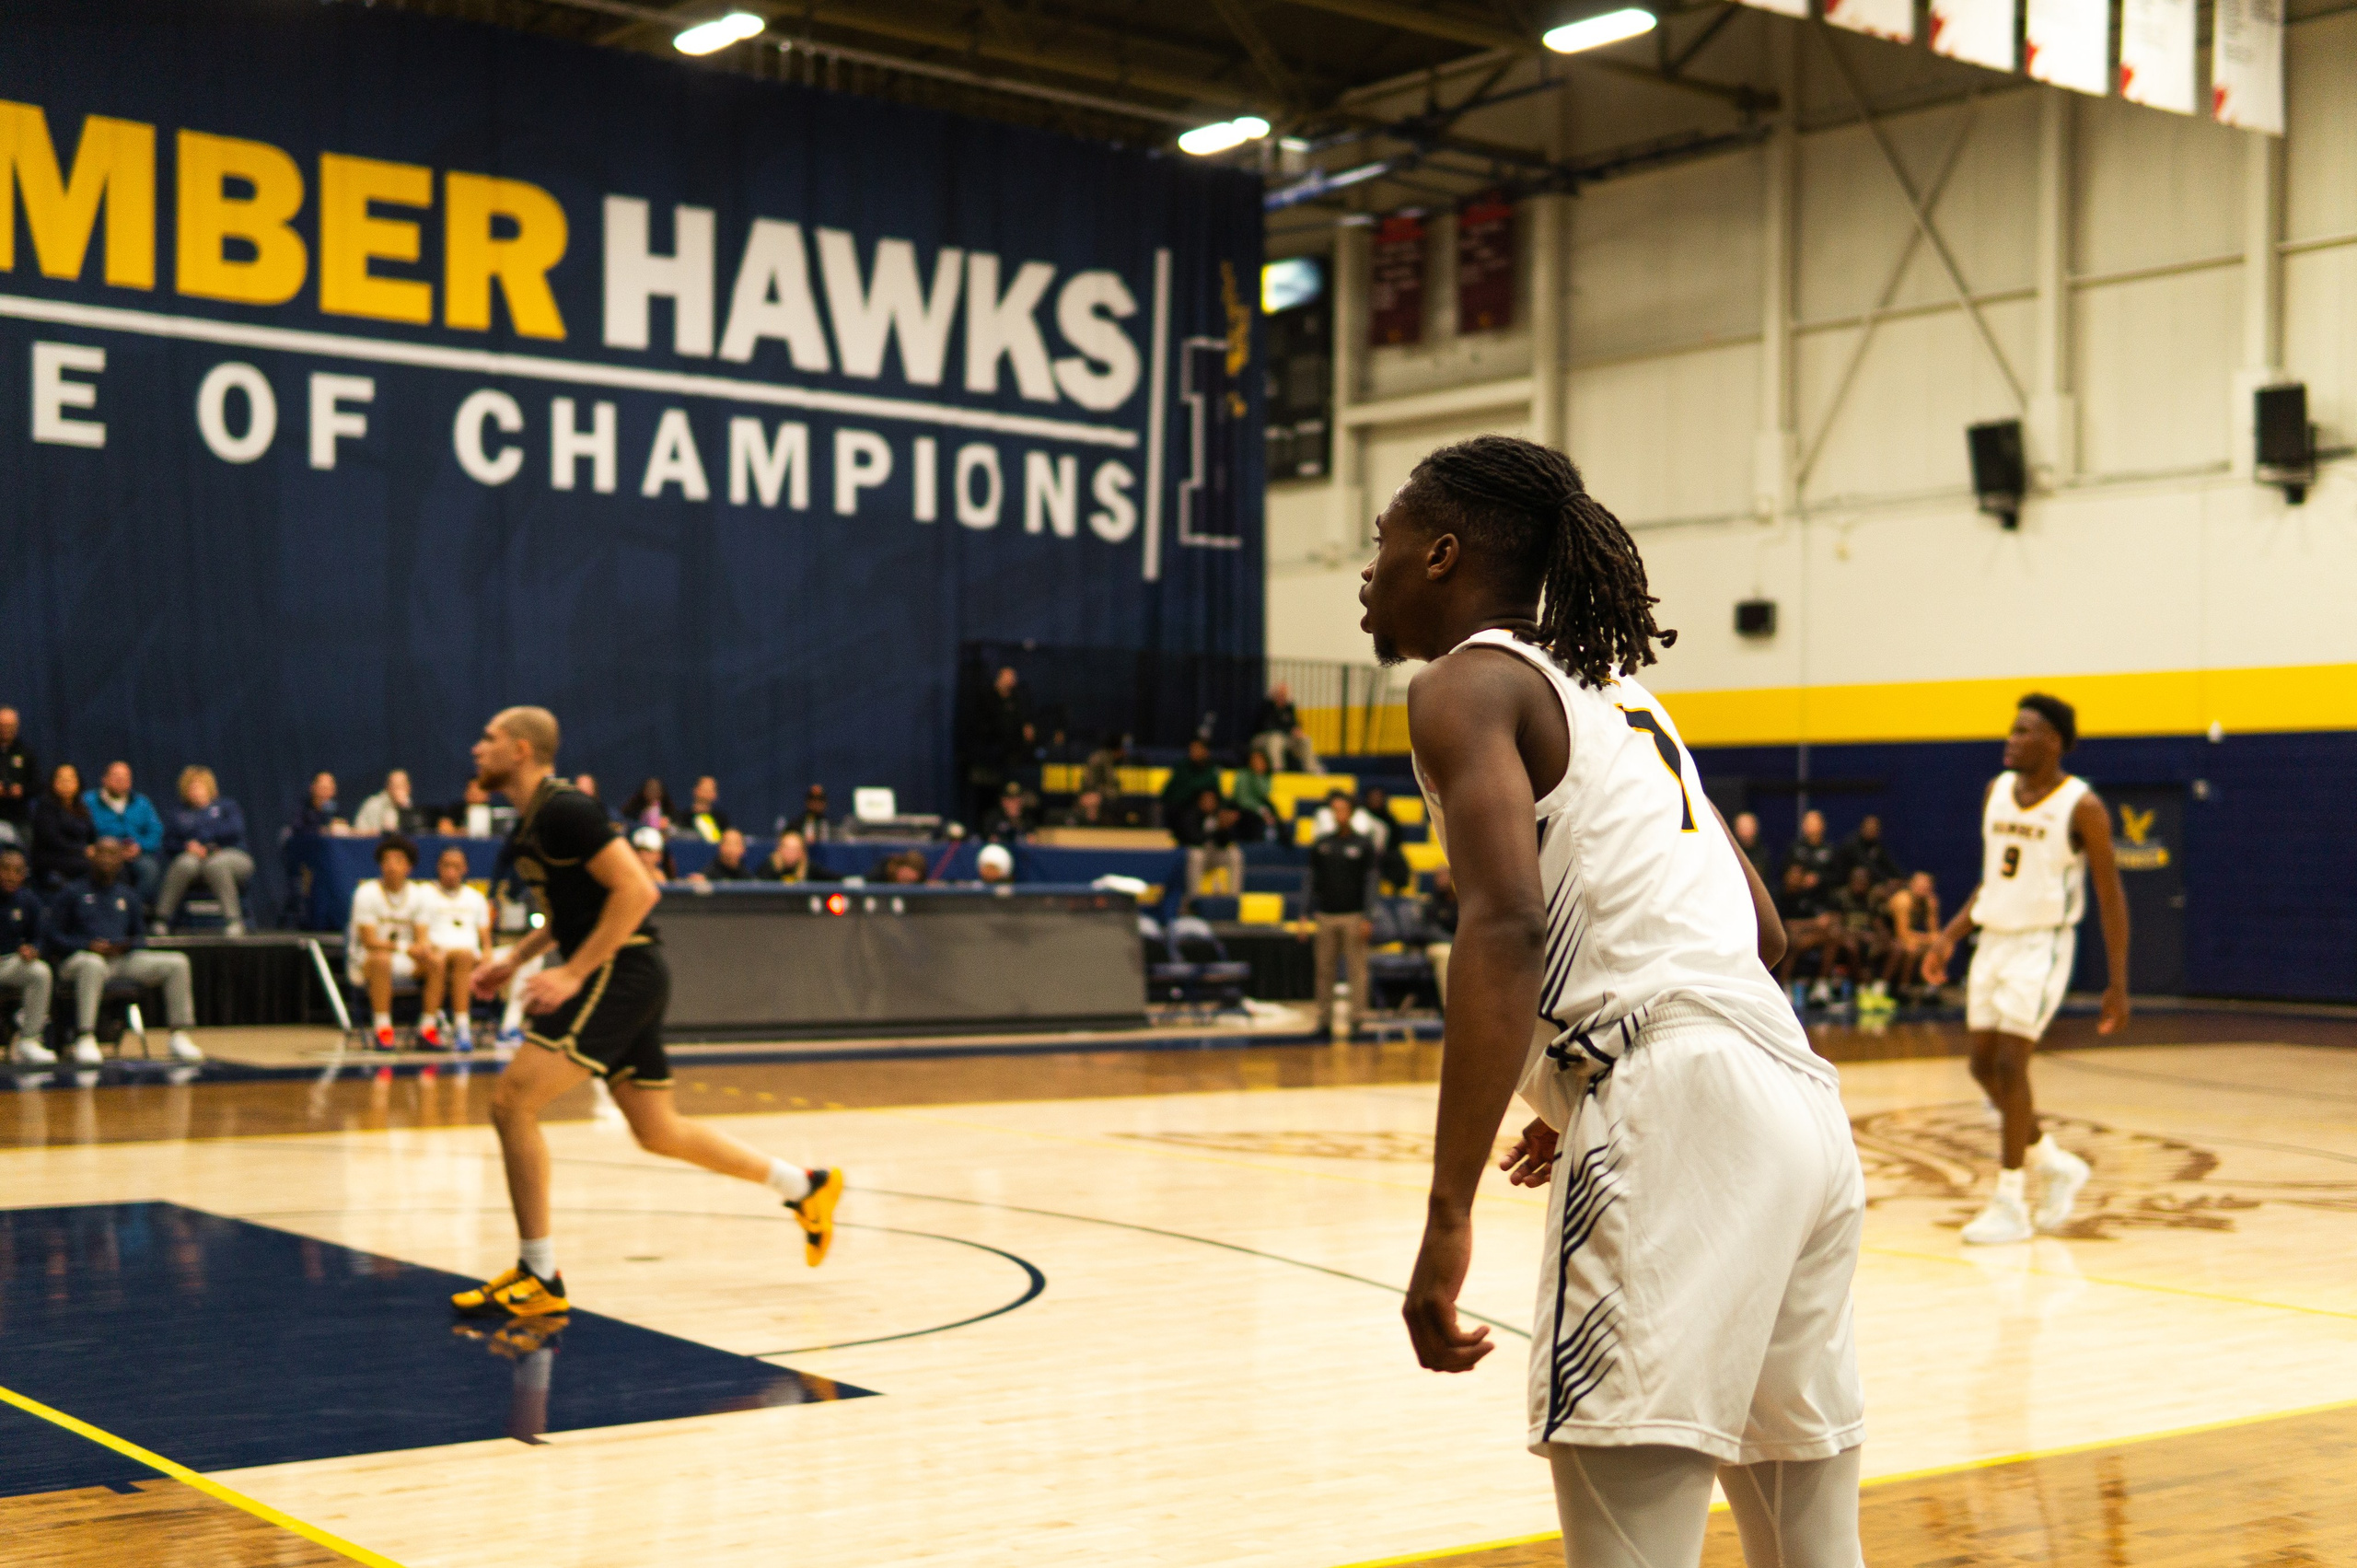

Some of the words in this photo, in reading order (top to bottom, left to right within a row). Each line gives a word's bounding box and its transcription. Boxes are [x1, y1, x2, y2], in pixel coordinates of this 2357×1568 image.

[603, 194, 1141, 411] HAWKS
[196, 361, 375, 470] OF
[453, 389, 1138, 542] CHAMPIONS
[2001, 845, 2020, 879] 9
